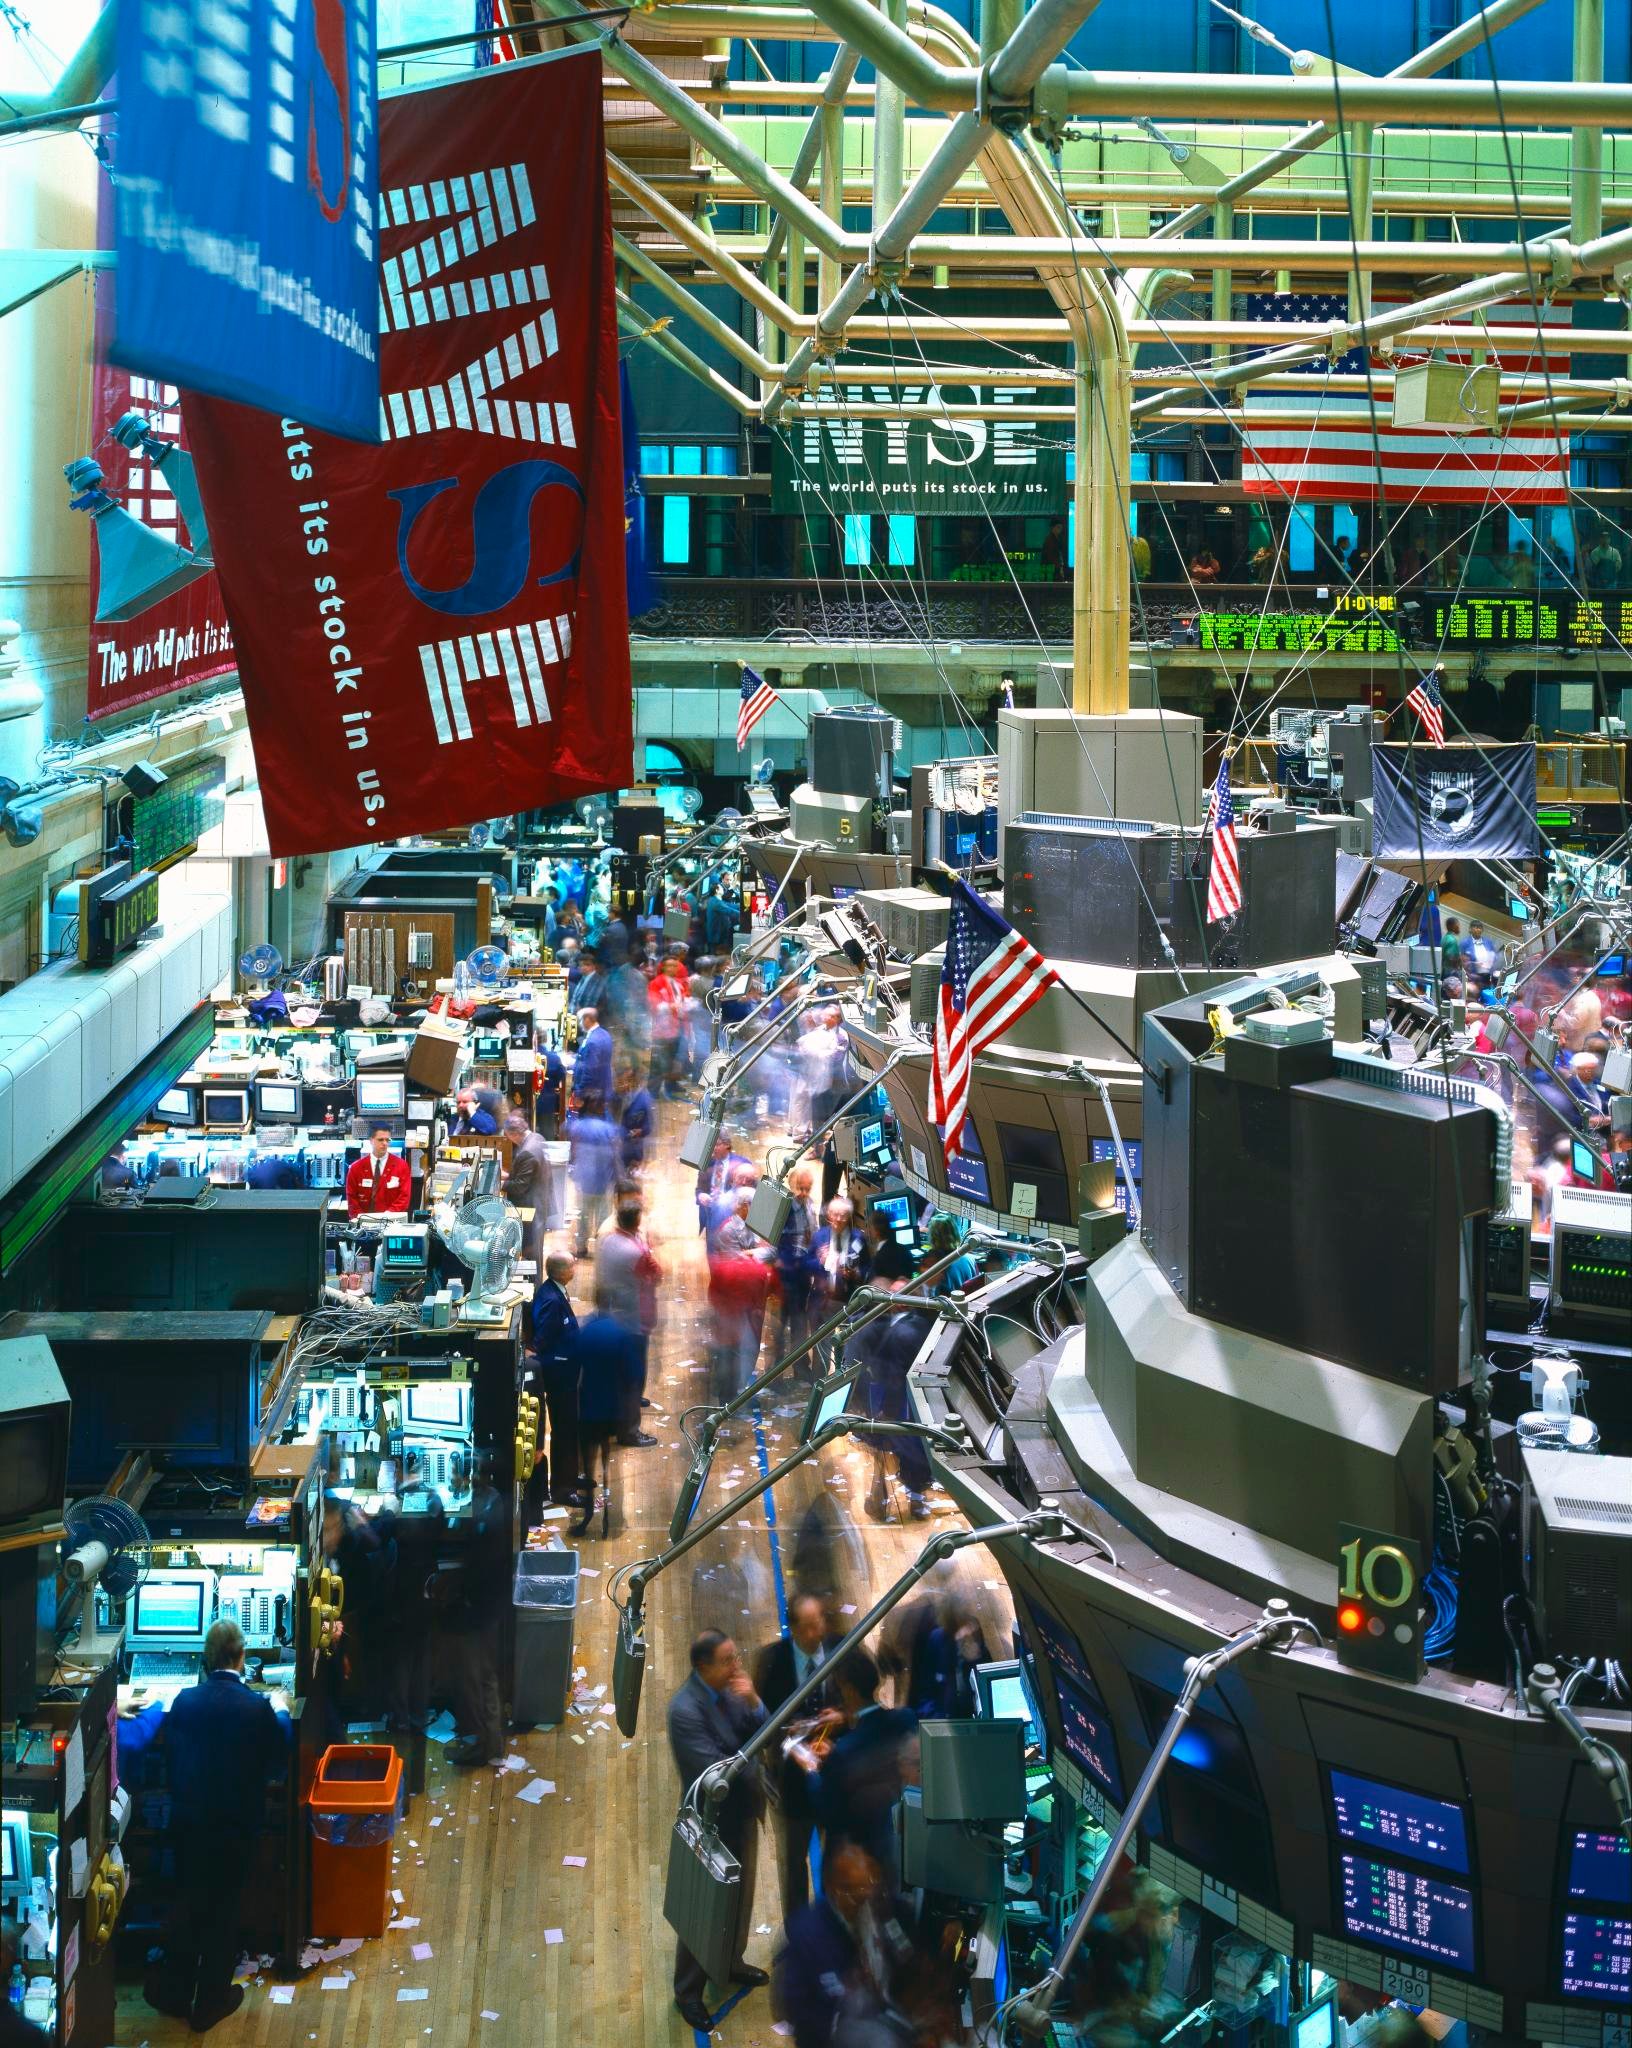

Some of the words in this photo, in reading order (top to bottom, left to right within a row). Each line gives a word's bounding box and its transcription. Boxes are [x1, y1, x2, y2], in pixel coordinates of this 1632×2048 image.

[804, 386, 1037, 466] NYSE
[790, 479, 821, 492] The
[829, 480, 874, 492] world
[882, 481, 917, 496] puts
[924, 480, 945, 494] its
[953, 481, 996, 495] stock
[1003, 481, 1018, 493] in
[1025, 482, 1048, 494] us.
[281, 418, 312, 481] uts
[299, 499, 329, 556] its
[315, 576, 363, 693] stock
[342, 710, 372, 750] in
[357, 769, 385, 827] us.
[98, 641, 127, 687] The
[841, 818, 850, 835] 5
[1340, 1538, 1415, 1607] 10
[1388, 1974, 1424, 1998] 2190
